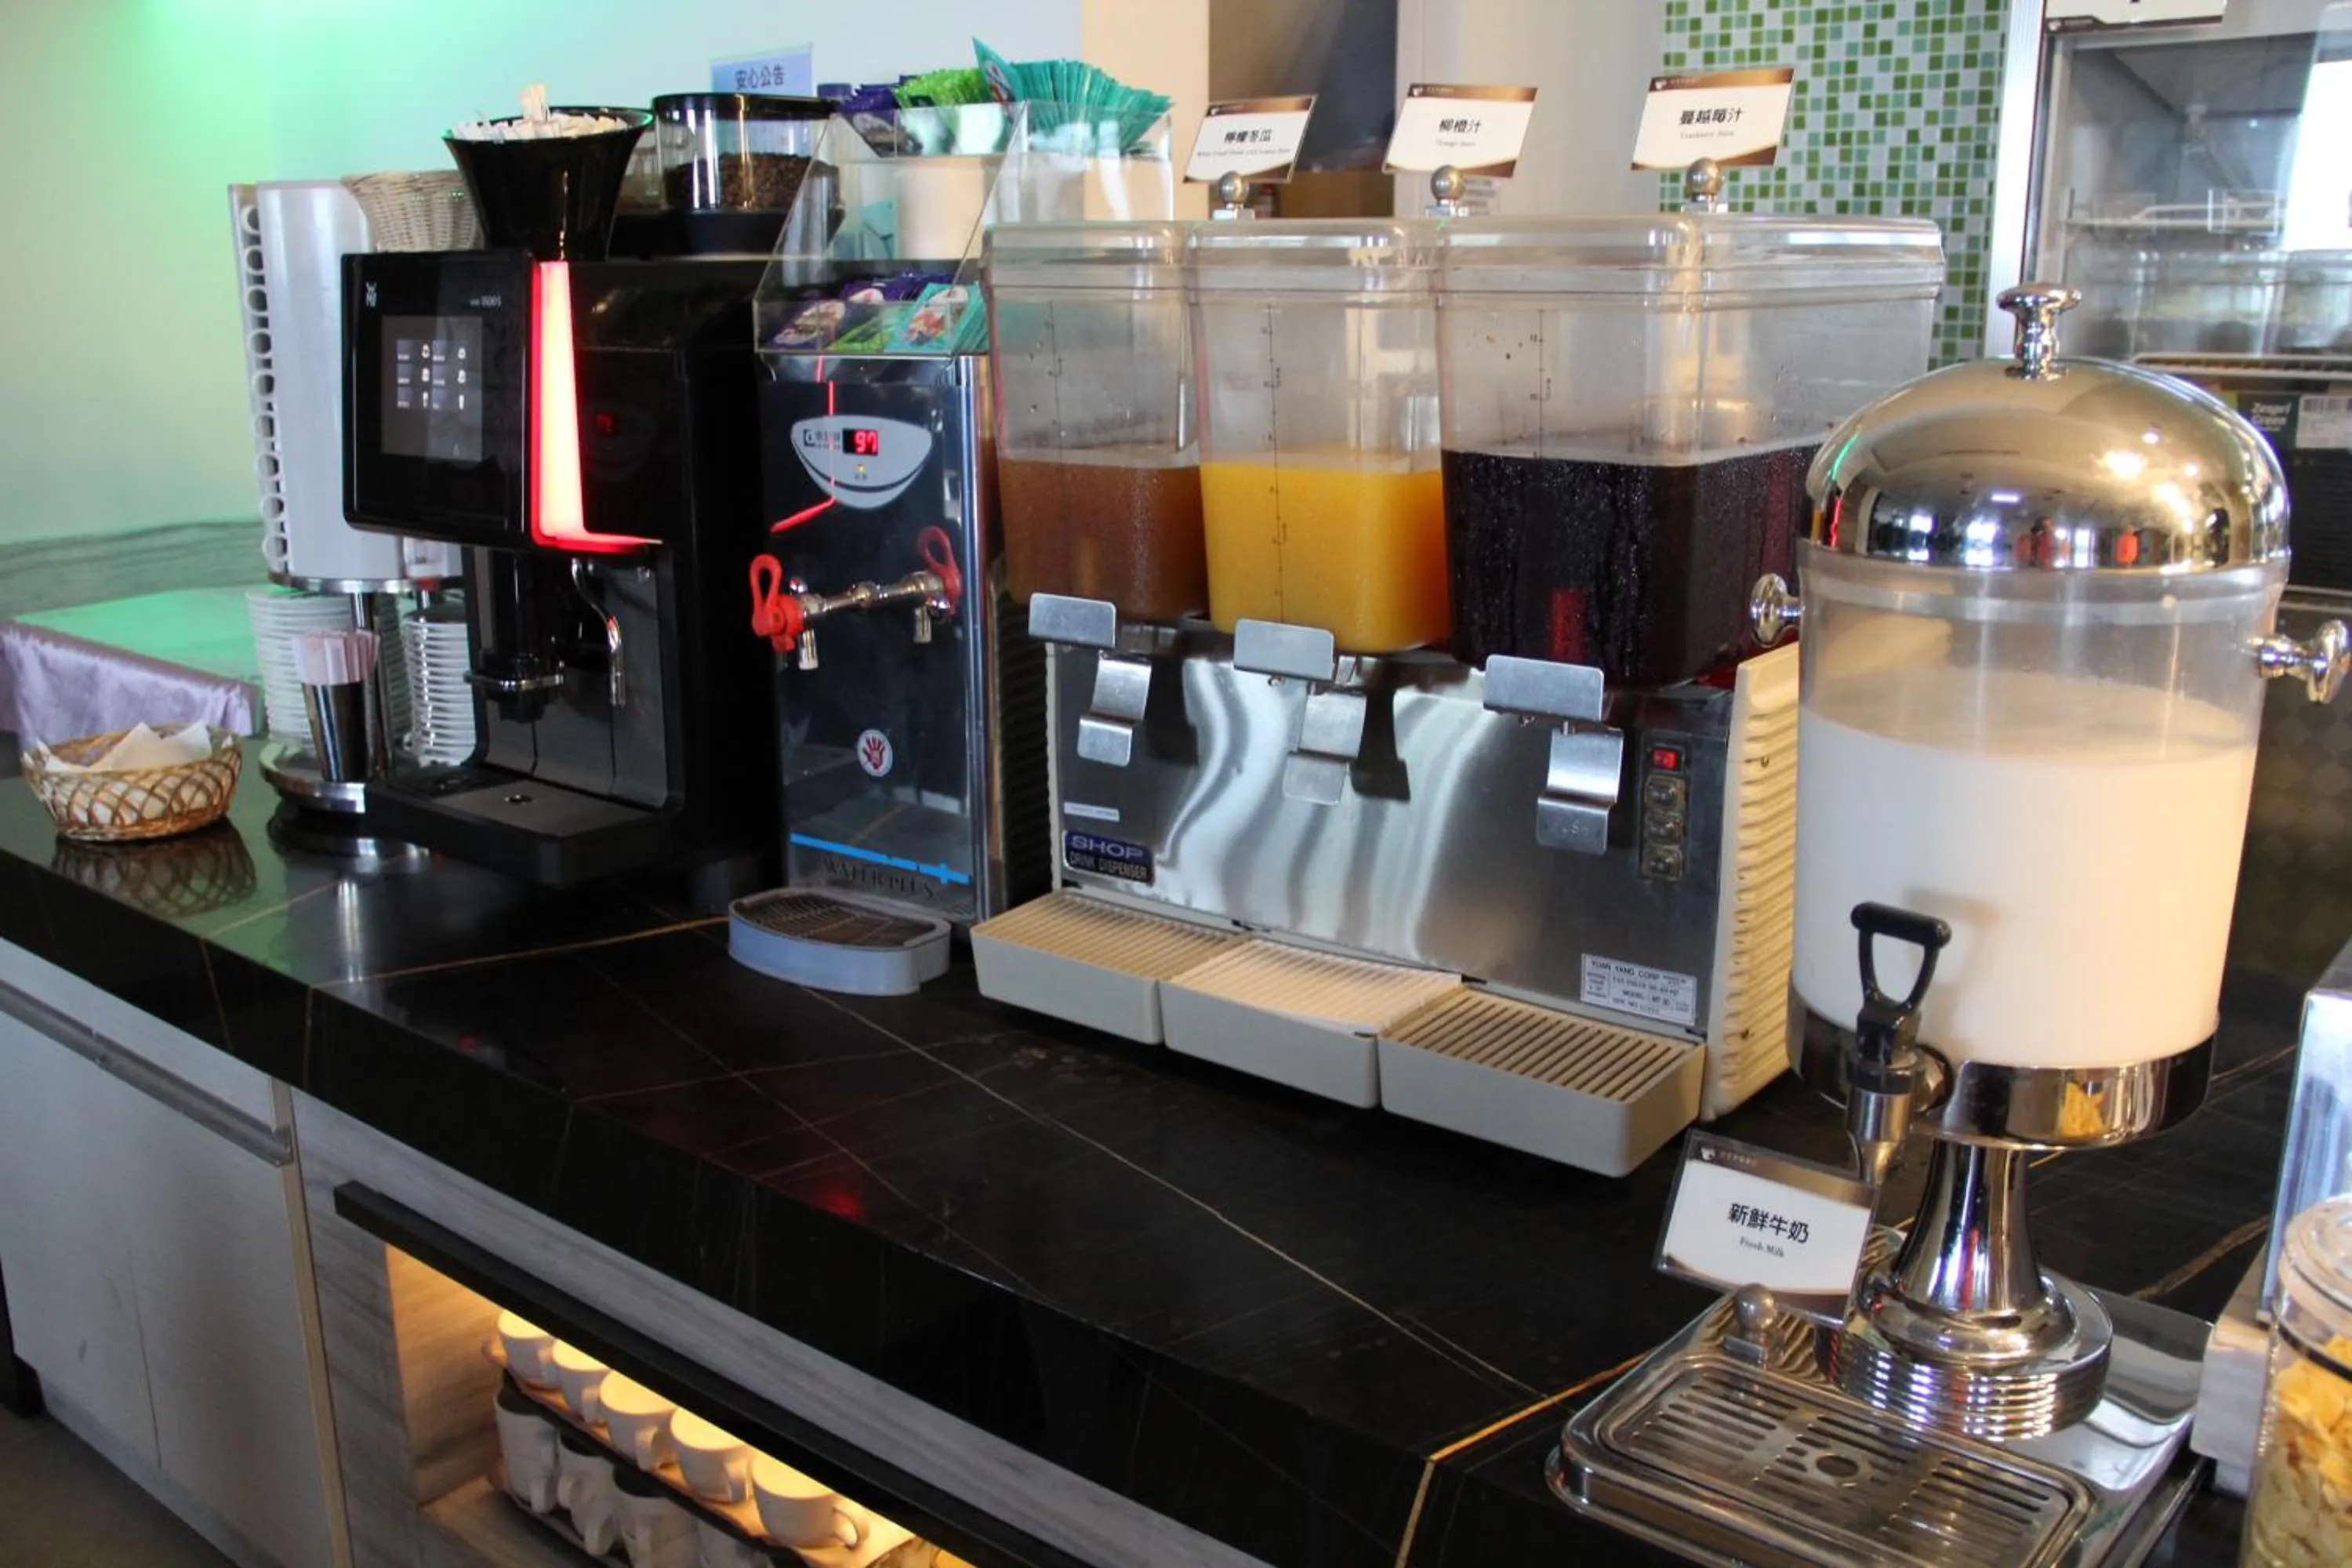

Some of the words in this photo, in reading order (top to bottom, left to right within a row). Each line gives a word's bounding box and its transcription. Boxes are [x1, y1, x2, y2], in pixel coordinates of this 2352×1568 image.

[735, 64, 785, 90] 安心公告
[1439, 118, 1482, 133] 柳橙汁
[1679, 107, 1744, 125] 蔓越莓汁
[855, 431, 877, 452] 97
[1071, 835, 1144, 858] SHOP
[1099, 858, 1148, 880] DISPENSER
[1727, 1202, 1809, 1244] 新鮮牛奶
[1766, 1243, 1785, 1258] Milk
